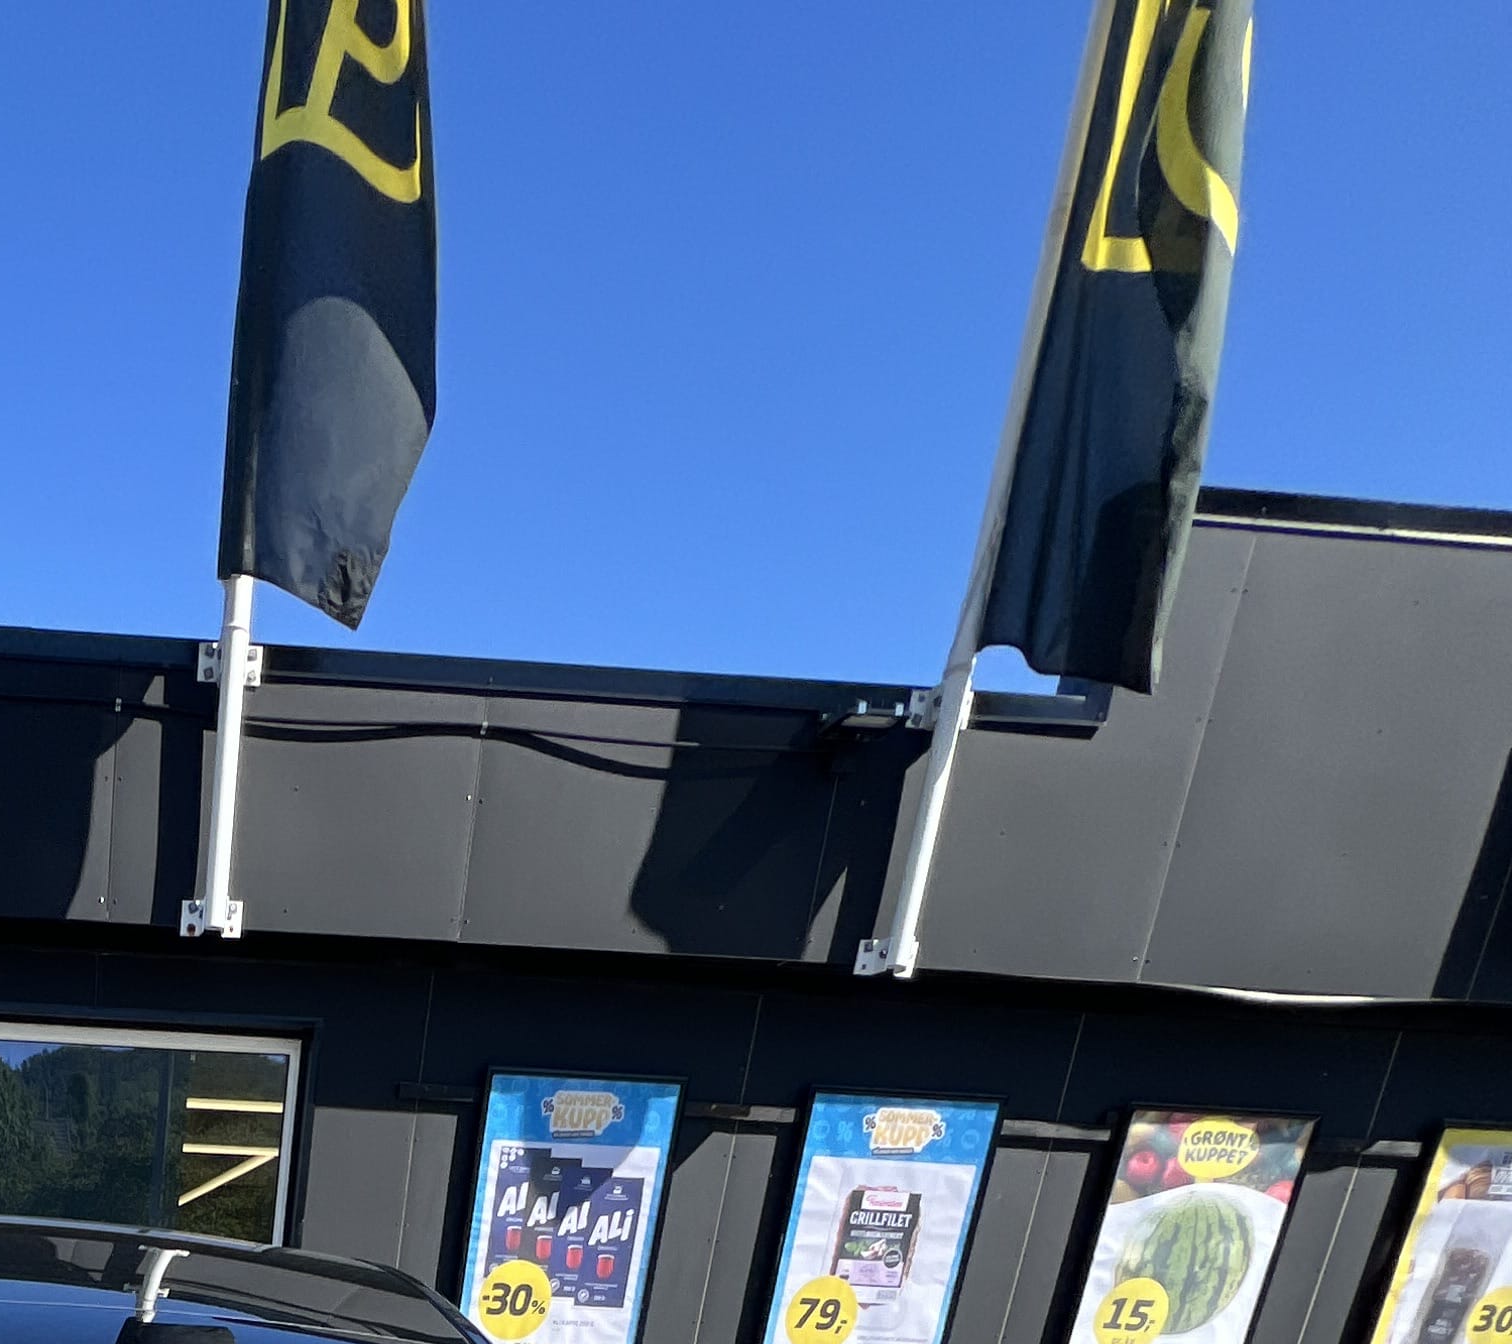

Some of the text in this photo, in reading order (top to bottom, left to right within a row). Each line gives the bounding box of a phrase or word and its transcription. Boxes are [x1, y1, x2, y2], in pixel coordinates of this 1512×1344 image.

[552, 1104, 610, 1131] KUPP
[872, 1124, 930, 1148] KUPP
[1185, 1147, 1248, 1165] KUPPET
[849, 1211, 912, 1228] GRILLFILET
